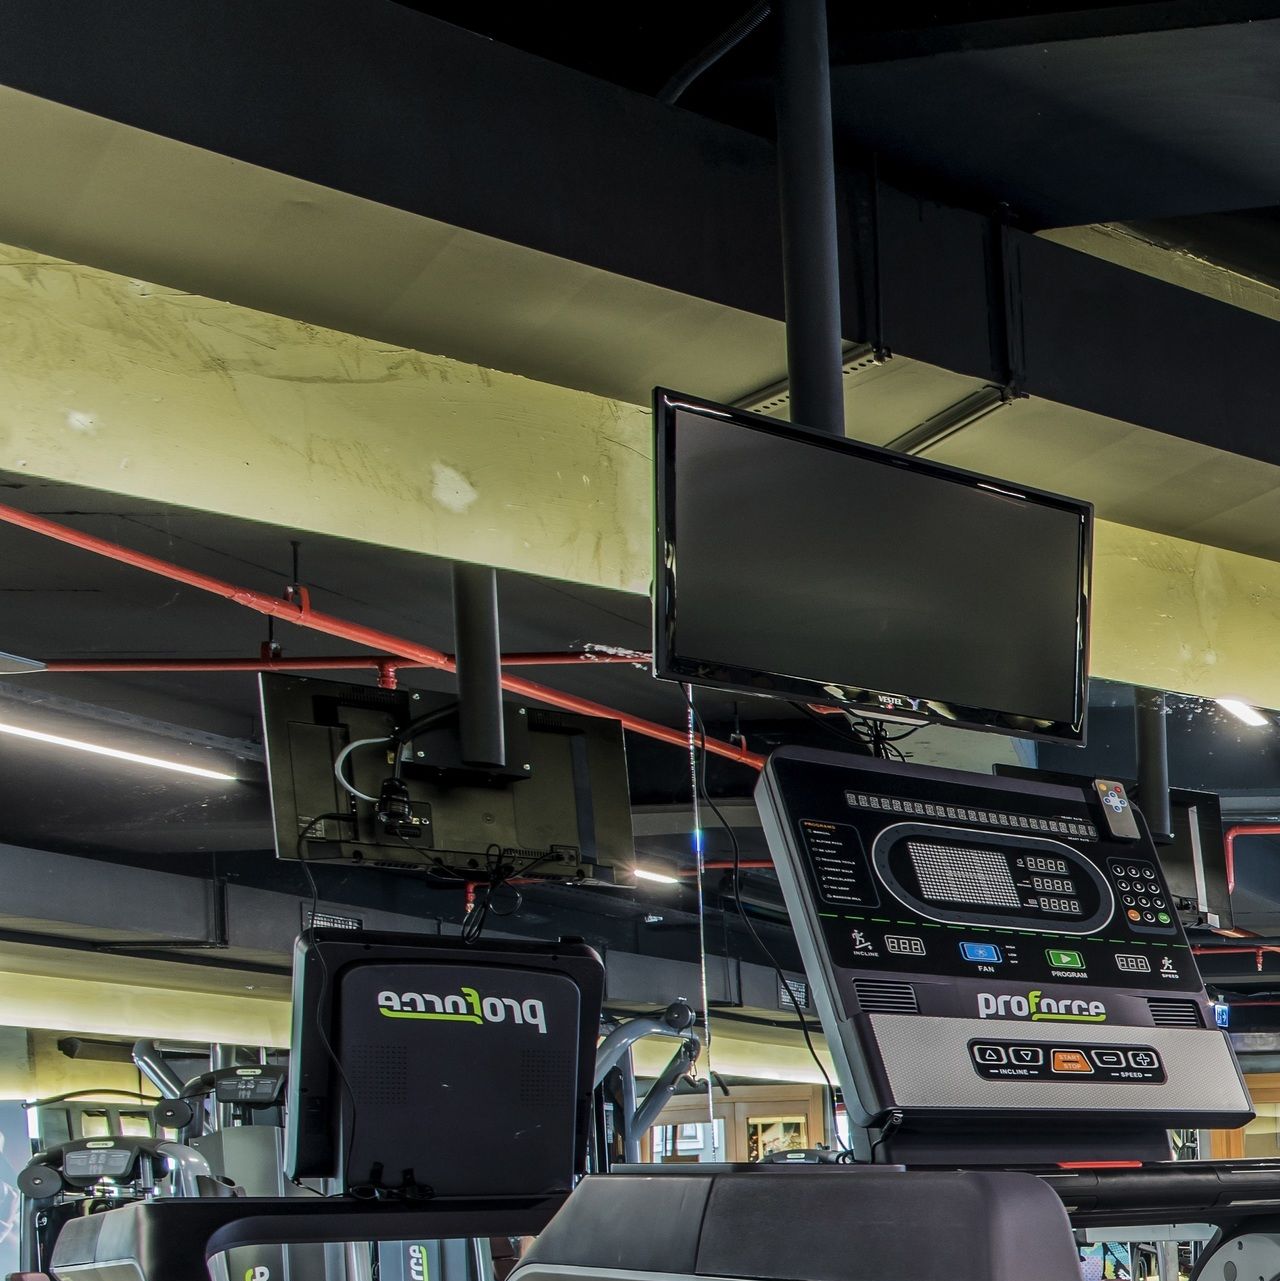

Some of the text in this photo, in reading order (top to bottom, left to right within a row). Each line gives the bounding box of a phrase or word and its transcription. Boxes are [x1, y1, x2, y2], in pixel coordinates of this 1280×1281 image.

[878, 695, 903, 706] VESTEL
[978, 965, 995, 973] FAN
[1051, 970, 1088, 978] PROGRAM
[977, 990, 1107, 1022] proforce
